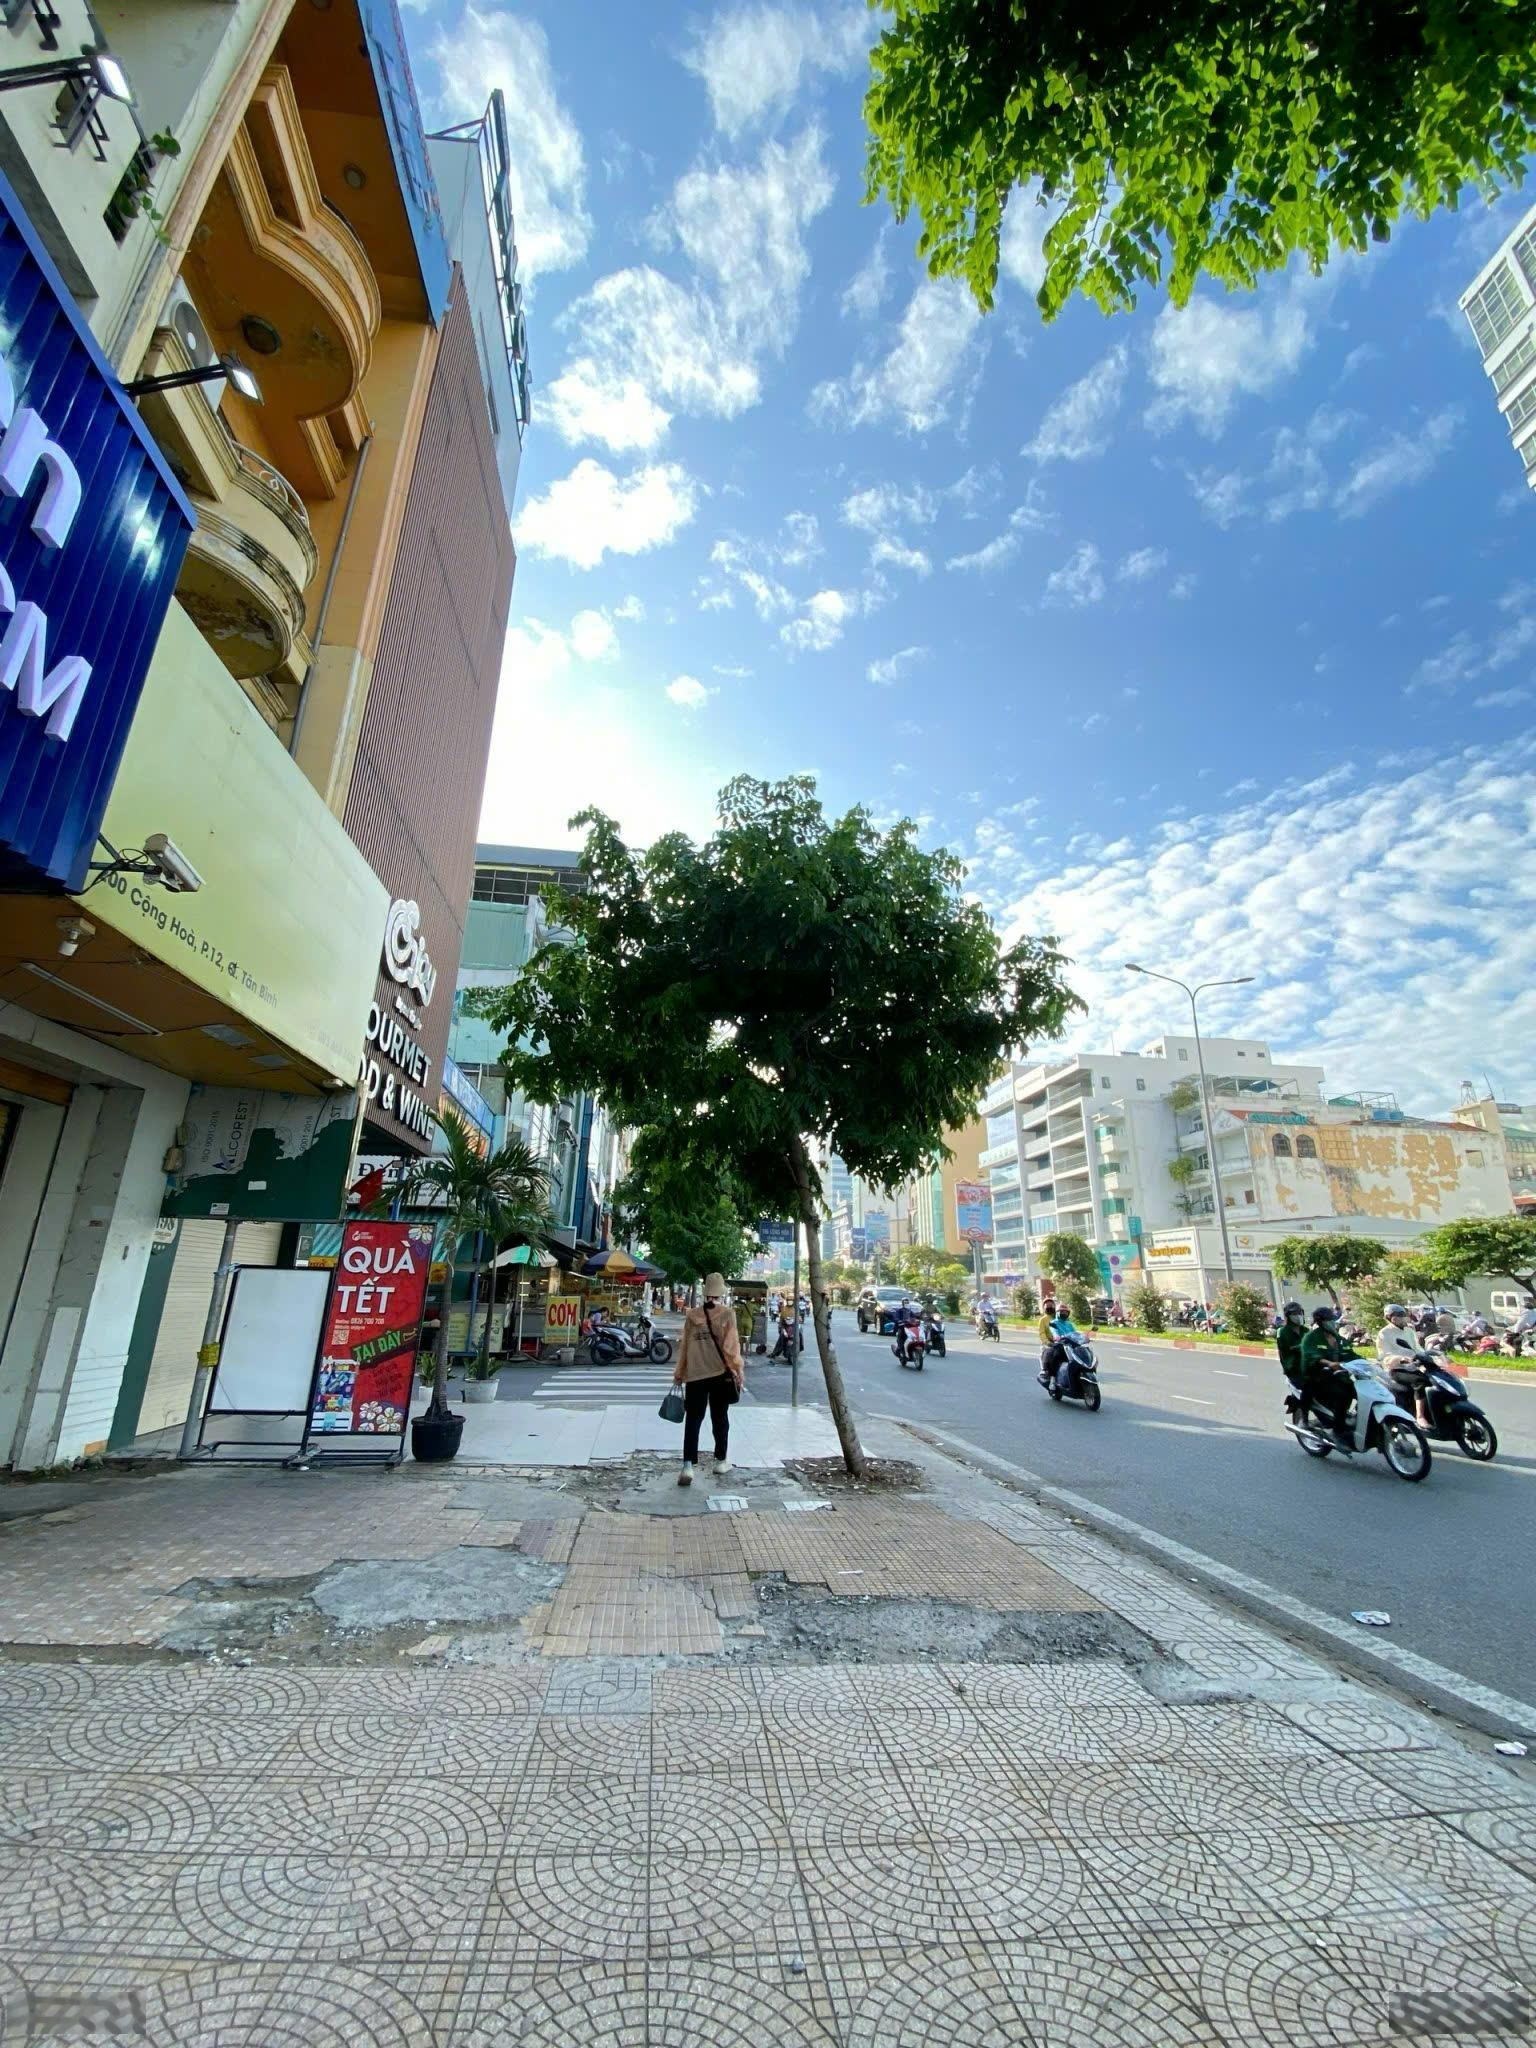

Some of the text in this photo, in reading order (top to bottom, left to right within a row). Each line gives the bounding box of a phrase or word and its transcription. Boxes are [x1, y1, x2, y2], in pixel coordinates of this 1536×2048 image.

[130, 888, 168, 929] Cộng
[170, 917, 197, 953] Hoà,
[241, 969, 257, 994] Tân
[259, 983, 279, 1008] Bình
[382, 1074, 394, 1110] &
[399, 1085, 435, 1141] WINE
[343, 1240, 415, 1274] QUÀ
[337, 1276, 395, 1313] TẾT
[352, 1330, 401, 1363] TẠI ĐÂY
